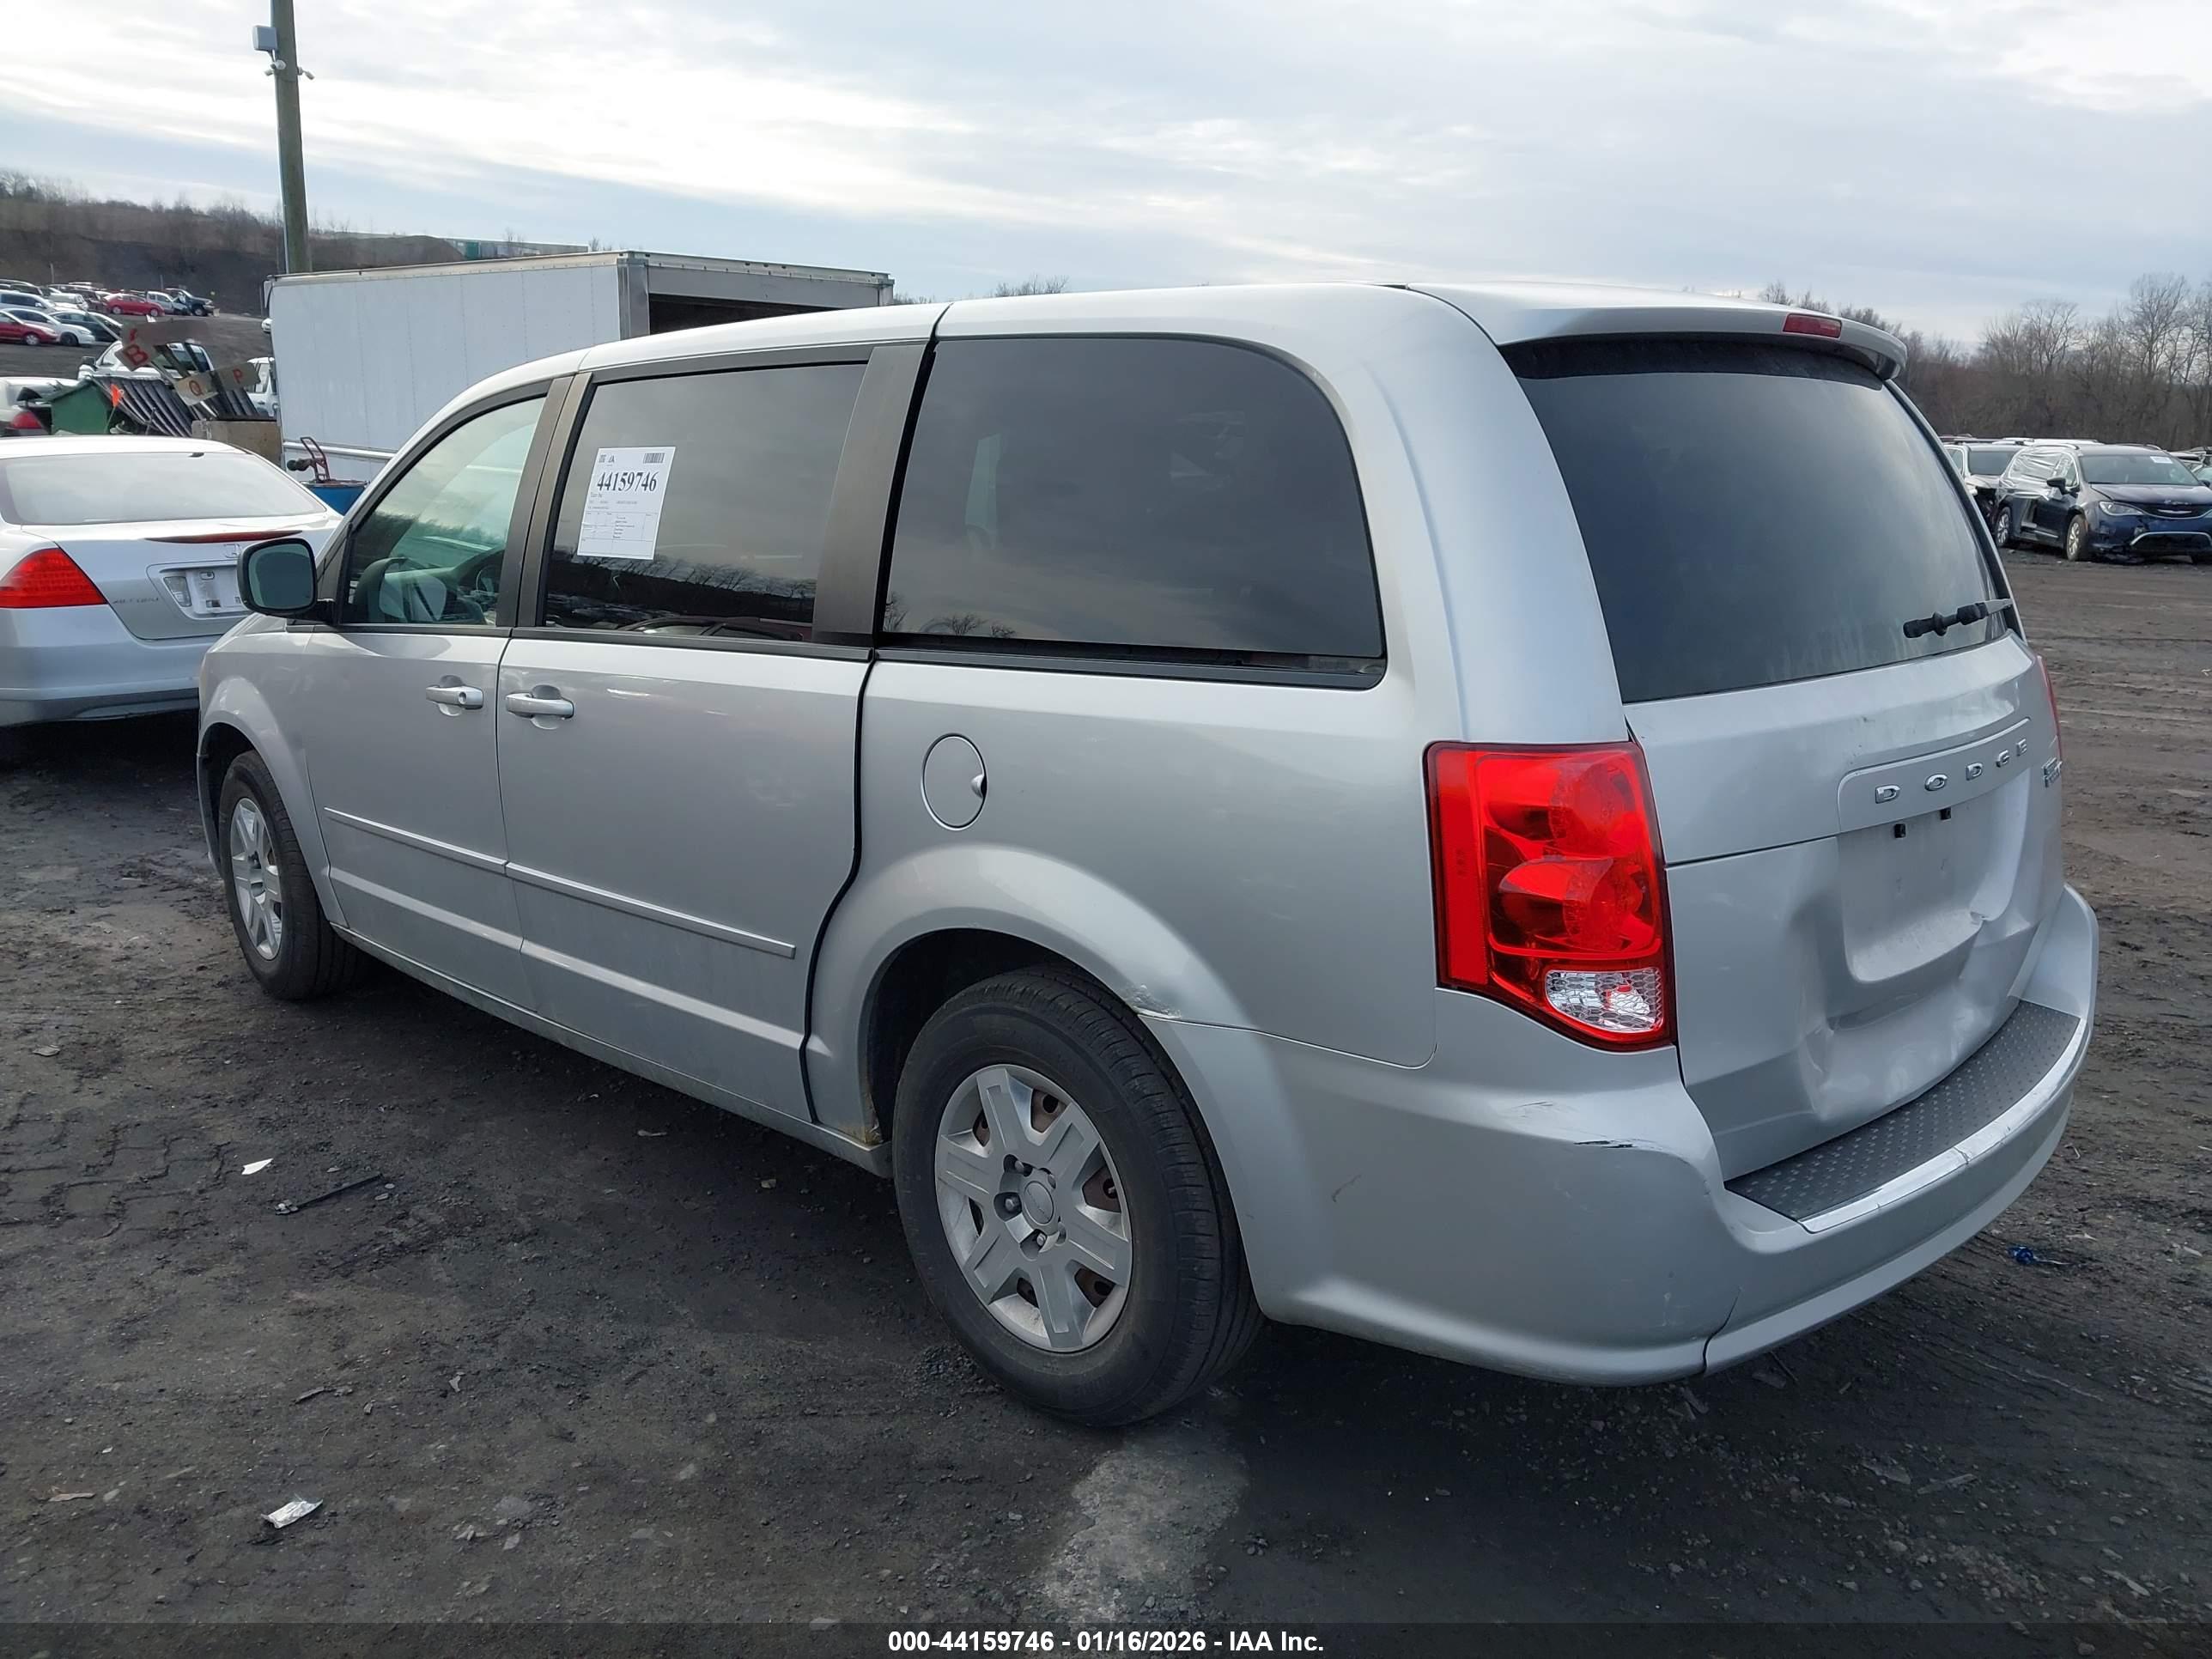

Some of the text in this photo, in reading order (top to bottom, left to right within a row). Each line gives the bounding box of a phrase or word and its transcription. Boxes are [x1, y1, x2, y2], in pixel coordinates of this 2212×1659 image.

[124, 344, 149, 366] B
[597, 471, 659, 492] 44159746
[1875, 738, 2028, 804] DODGE
